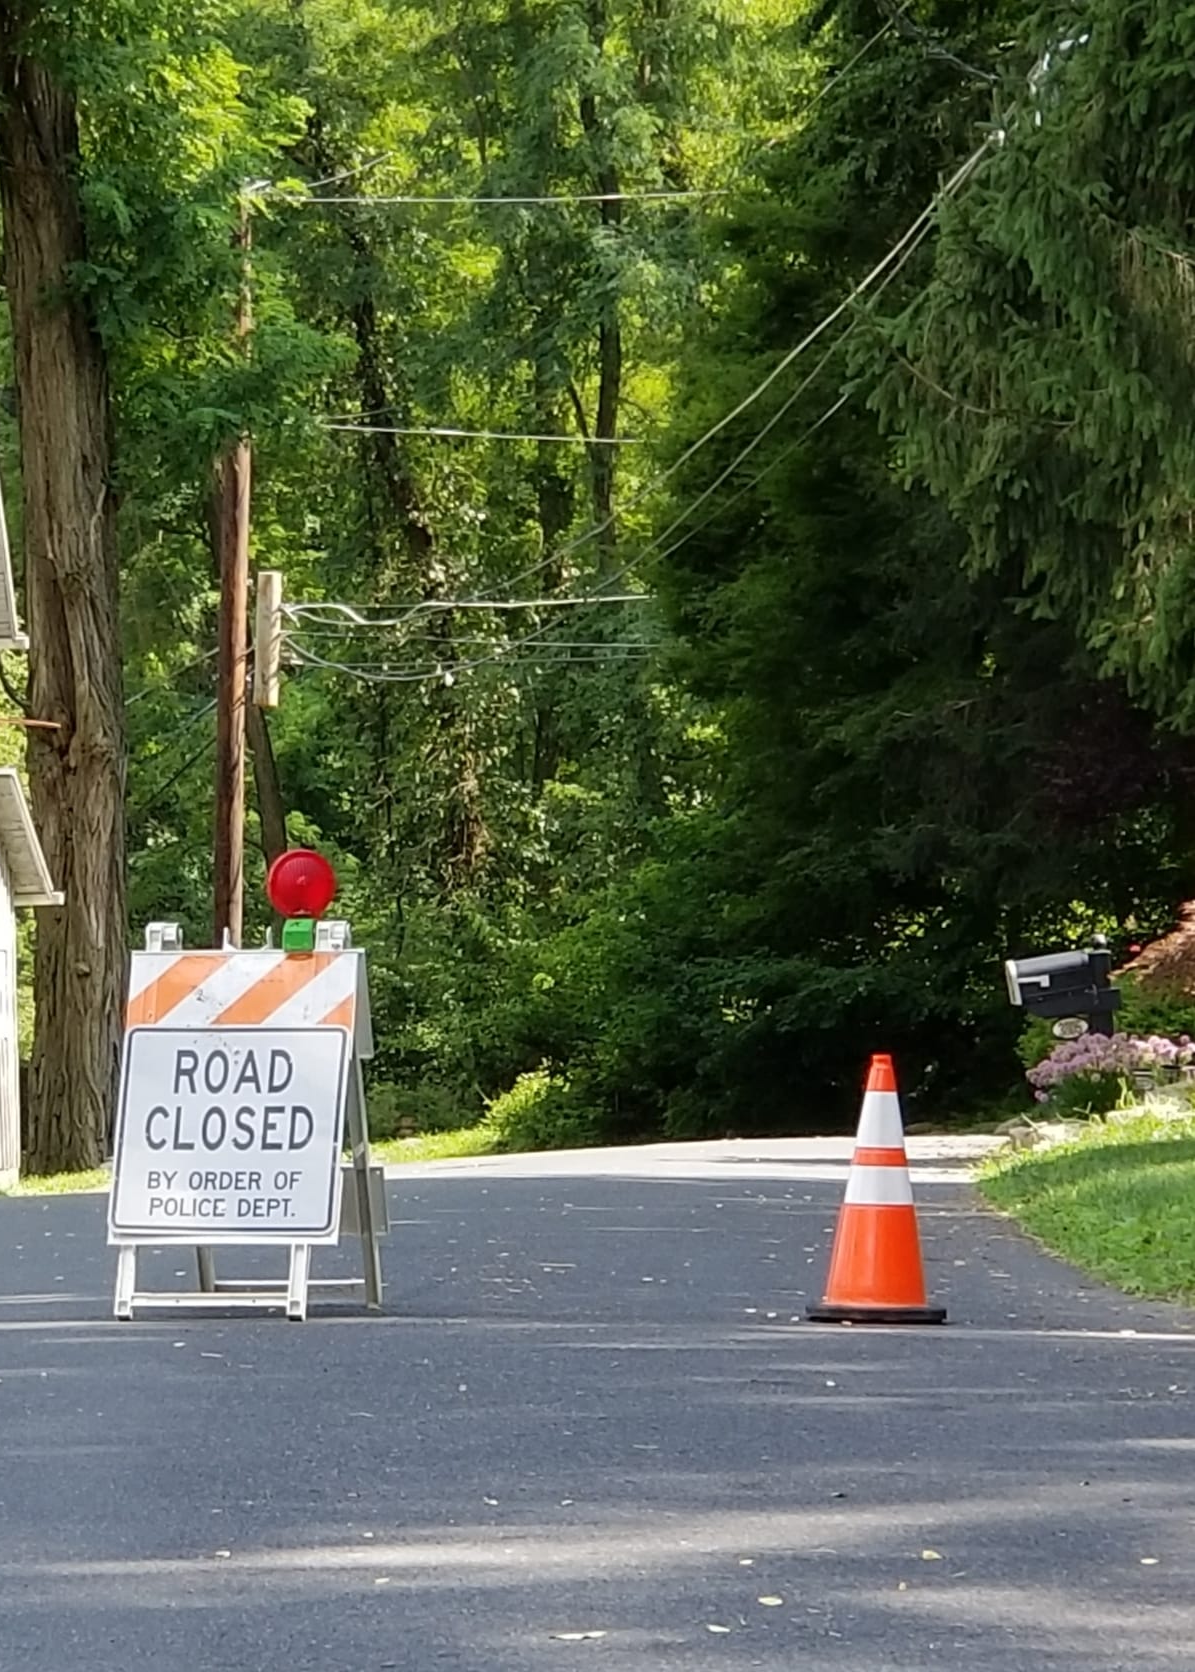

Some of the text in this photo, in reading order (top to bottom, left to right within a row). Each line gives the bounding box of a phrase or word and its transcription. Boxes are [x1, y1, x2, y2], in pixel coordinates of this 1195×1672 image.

[173, 1049, 293, 1094] ROAD
[145, 1105, 314, 1151] CLOSED
[147, 1171, 303, 1191] BY ORDER OF
[149, 1197, 296, 1218] POLICE DEPT.
